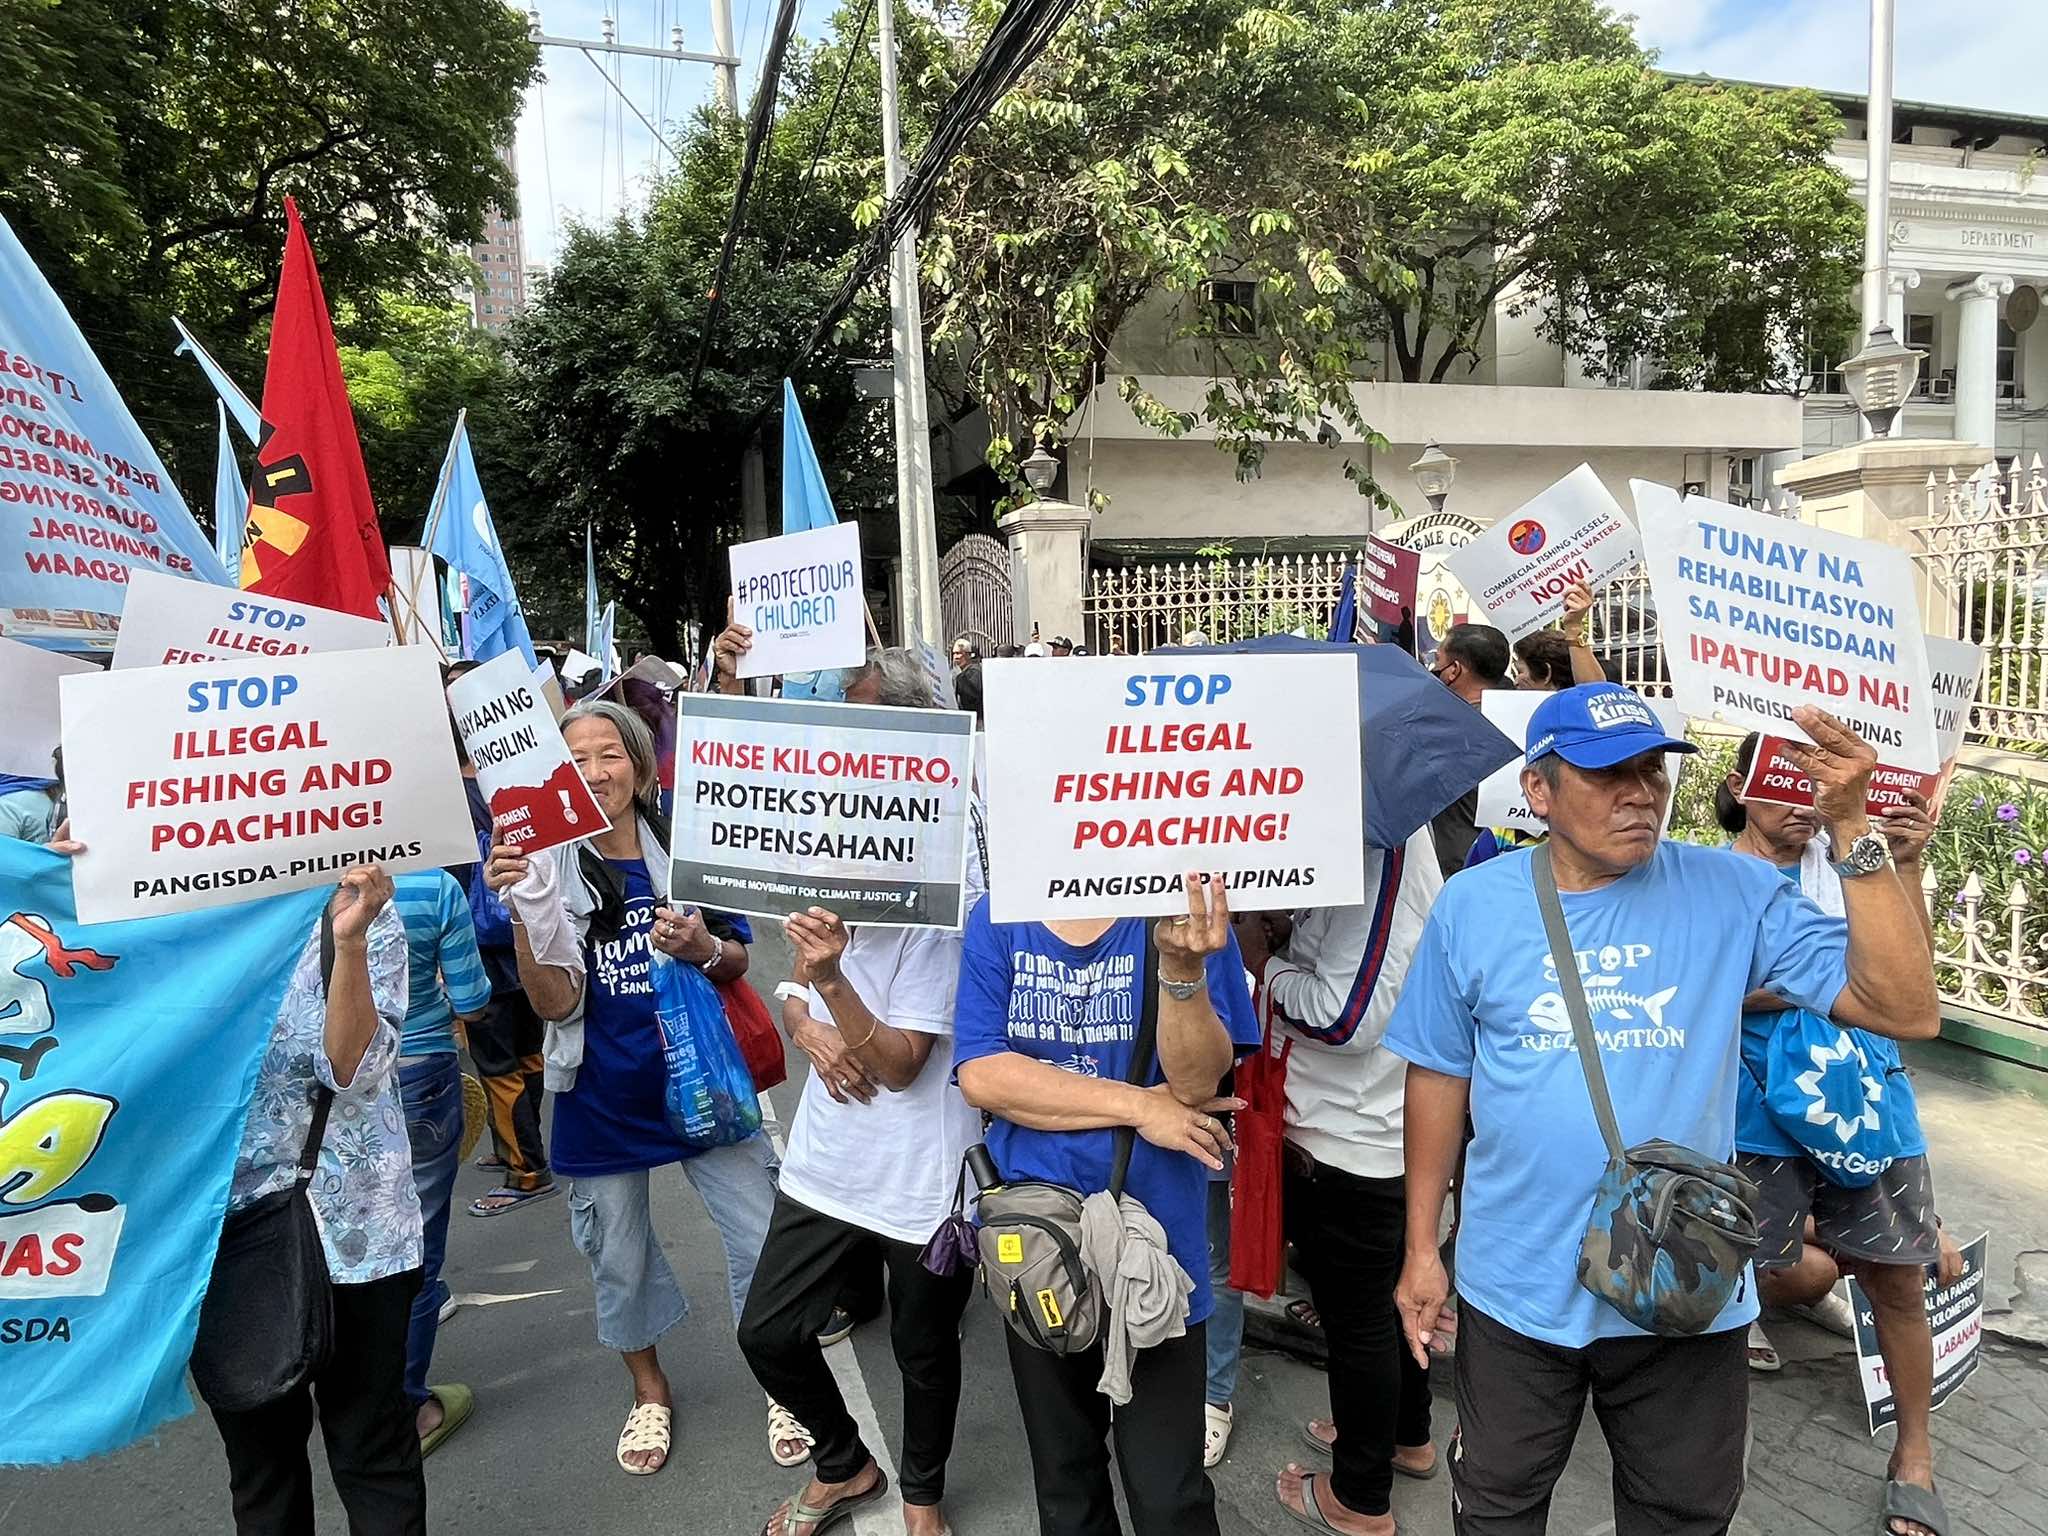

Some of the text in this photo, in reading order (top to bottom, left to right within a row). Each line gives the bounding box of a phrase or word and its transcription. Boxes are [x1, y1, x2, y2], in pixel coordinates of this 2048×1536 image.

[1961, 229, 2034, 248] DEPARTMENT
[1483, 512, 1610, 599] COMMERCIAL FISHING VESSELS
[1487, 520, 1622, 611] OUT OF THE MUNICIPAL WATERS
[1698, 521, 1864, 588] TUNAY NA
[738, 560, 854, 604] #PROTECTOUR
[1530, 558, 1594, 605] NOW!
[1678, 556, 1894, 630] REHABILITASYON
[228, 602, 306, 631] STOP
[1689, 594, 1895, 665] SA PANGISDAAN
[1124, 674, 1232, 707] STOP
[1690, 633, 1910, 714] IPATUPAD NA!
[1955, 676, 1972, 699] NG
[188, 674, 299, 713] STOP
[505, 687, 534, 716] NG
[1588, 692, 1617, 707] ATIN
[1590, 703, 1650, 723] Kinse
[173, 721, 328, 760] ILLEGAL
[1105, 722, 1252, 753] ILLEGAL
[126, 758, 392, 809] FISHING AND
[692, 740, 959, 788] KINSE KILOMETRO,
[1762, 773, 1793, 790] FOR
[696, 780, 940, 823] PROTEKSYUNAN!
[1053, 766, 1304, 803] FISHING AND
[151, 801, 382, 852] POACHING!
[712, 822, 914, 863] DEPENSAHAN!
[1073, 813, 1290, 850] POACHING!
[133, 841, 422, 899] PANGISDA-PILIPINAS
[702, 874, 901, 902] PHILIPPINE MOVEMENT FOR CLIMATE JUSTICE
[1518, 1026, 1685, 1052] RECLMATION
[1937, 1290, 1950, 1305] NA
